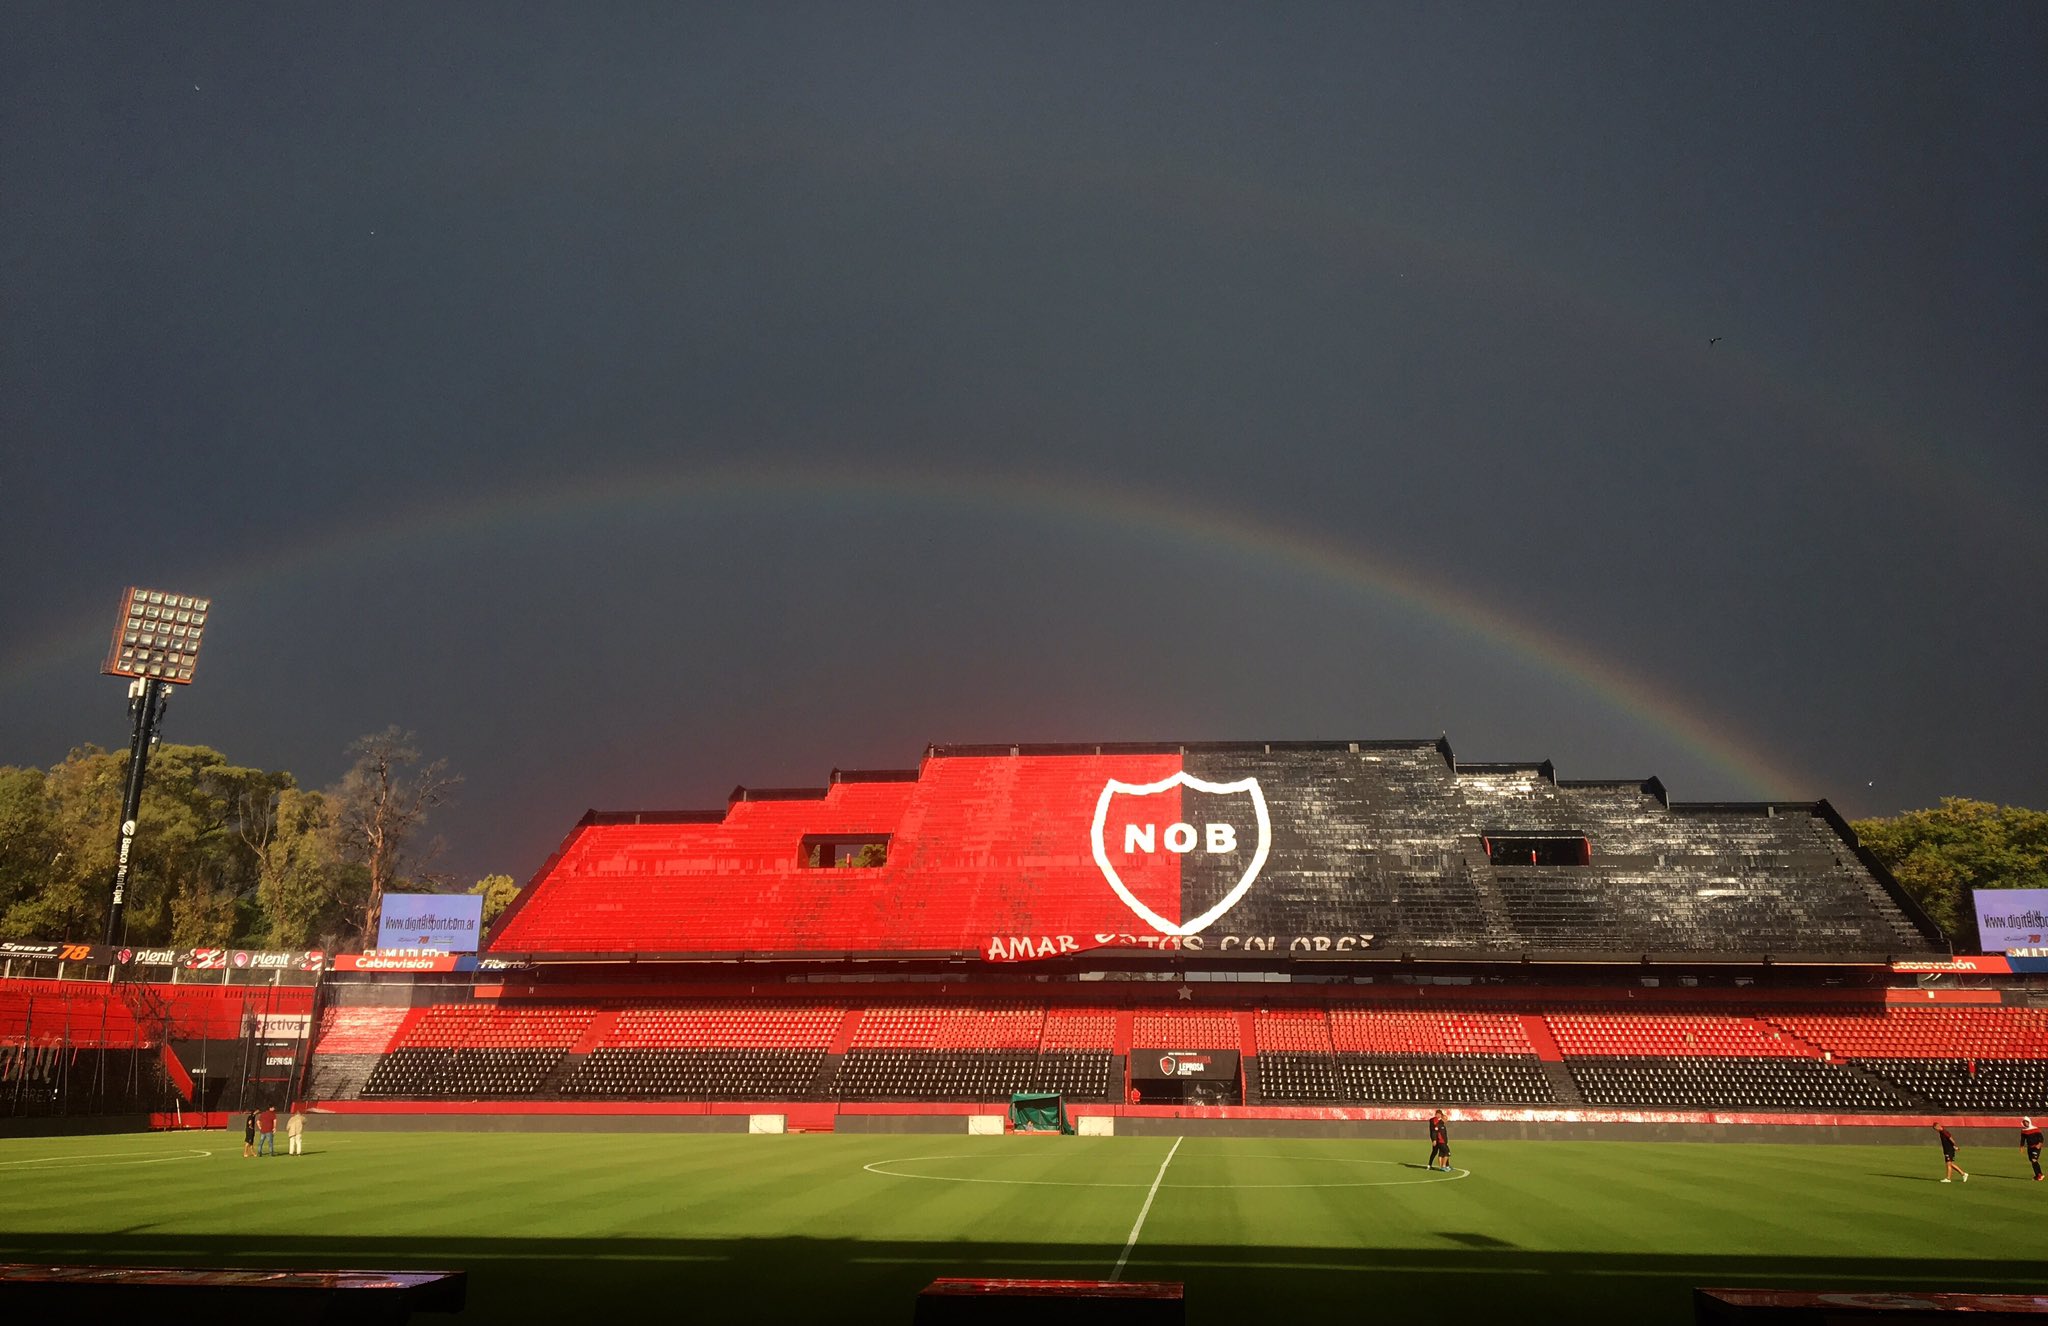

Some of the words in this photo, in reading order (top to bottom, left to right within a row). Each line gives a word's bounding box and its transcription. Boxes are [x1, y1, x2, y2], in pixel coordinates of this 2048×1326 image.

[1124, 822, 1238, 854] NOB
[119, 838, 132, 863] Banco
[113, 865, 128, 905] Municipal
[0, 942, 58, 953] Sport
[58, 944, 92, 960] 78
[134, 949, 175, 965] plenit
[988, 935, 1080, 961] AMAR
[250, 952, 289, 967] plenit
[355, 957, 434, 969] Cablevisión
[1179, 1062, 1205, 1071] LEPROSA
